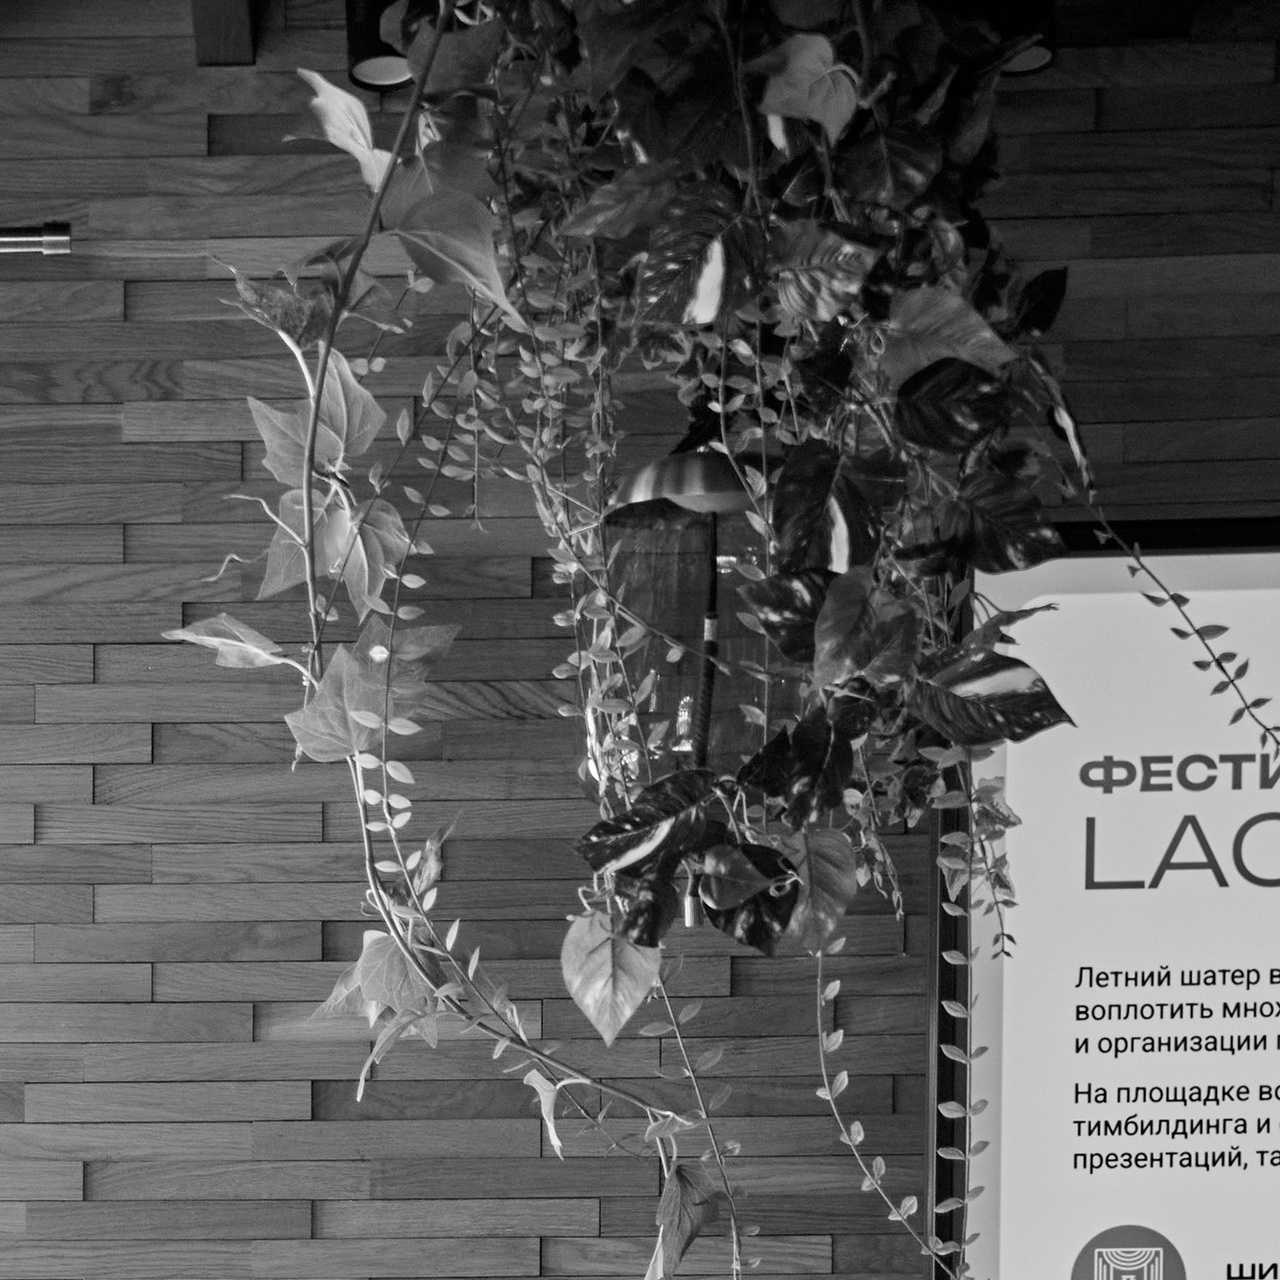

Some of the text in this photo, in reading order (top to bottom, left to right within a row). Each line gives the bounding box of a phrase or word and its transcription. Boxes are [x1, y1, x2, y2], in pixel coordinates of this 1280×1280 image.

[1079, 753, 1280, 795] ФЕСТИ
[1074, 964, 1171, 989] Летний
[1180, 968, 1261, 991] шатер
[1075, 1001, 1280, 1022] воплотить мно
[1074, 1037, 1089, 1054] и
[1097, 1034, 1267, 1059] организации
[1074, 1082, 1108, 1104] На
[1116, 1084, 1251, 1107] площадке
[1072, 1113, 1271, 1140] тимбилдинга и
[1073, 1145, 1280, 1175] презентаций, та
[1226, 1262, 1279, 1280] ши
